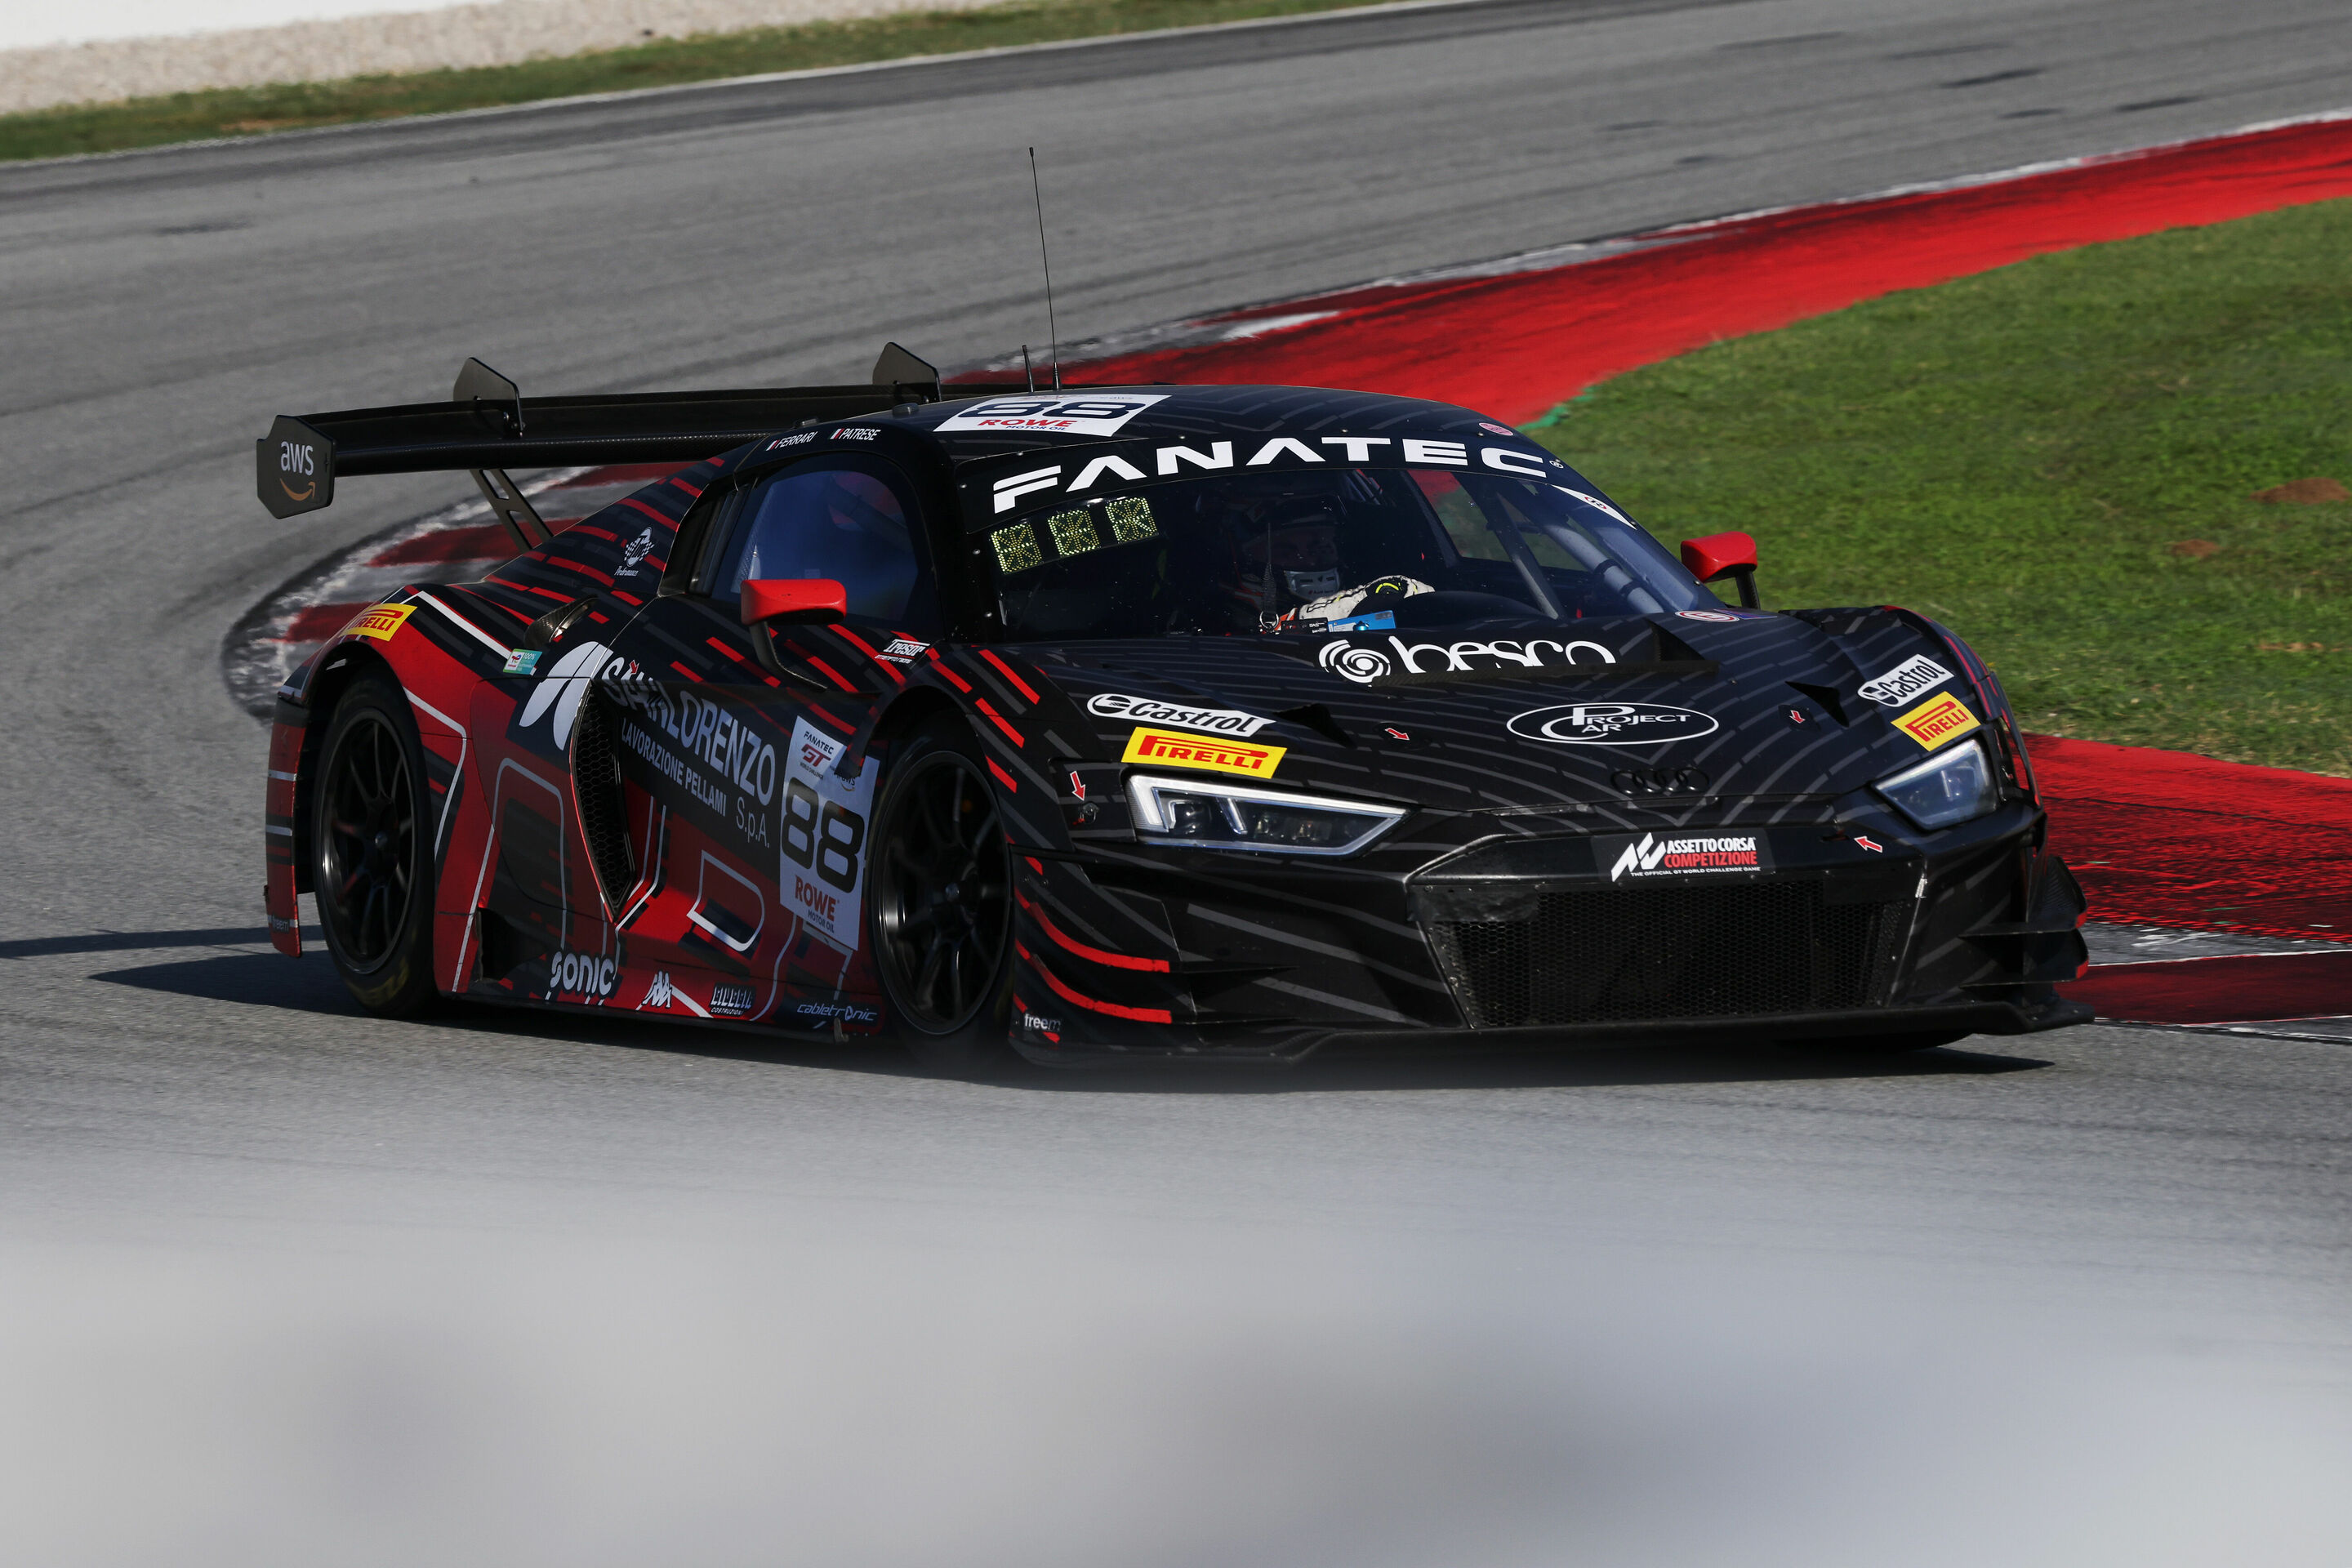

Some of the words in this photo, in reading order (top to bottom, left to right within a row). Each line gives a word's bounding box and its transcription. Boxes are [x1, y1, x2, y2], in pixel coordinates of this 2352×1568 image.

[958, 401, 1146, 419] 88
[839, 429, 881, 440] PATRESE
[978, 419, 1077, 427] ROWE
[775, 431, 817, 448] FERRARI
[281, 441, 314, 475] aws
[993, 437, 1547, 514] FANATEC
[883, 639, 930, 657] Tresor
[1878, 659, 1946, 698] Castrol
[1129, 702, 1256, 733] Castrol
[1572, 706, 1691, 726] PROJECT
[1904, 700, 1970, 742] PIRELLI
[804, 731, 835, 755] FANATEC
[1137, 735, 1268, 770] PIRELLI
[621, 717, 684, 786] LAVORAZIONE
[685, 766, 726, 817] PELLAMI
[801, 743, 831, 768] GT
[736, 796, 769, 849] S.p.A.
[782, 777, 865, 893] 88
[1667, 839, 1717, 854] ASSETTO
[1718, 837, 1756, 852] CORSA
[1664, 851, 1757, 868] COMPETIZIONE
[795, 875, 837, 921] ROWE
[808, 909, 826, 928] MOTOR
[826, 920, 835, 933] OIL
[797, 1002, 878, 1021] cabletronic
[1024, 1013, 1062, 1031] freem
